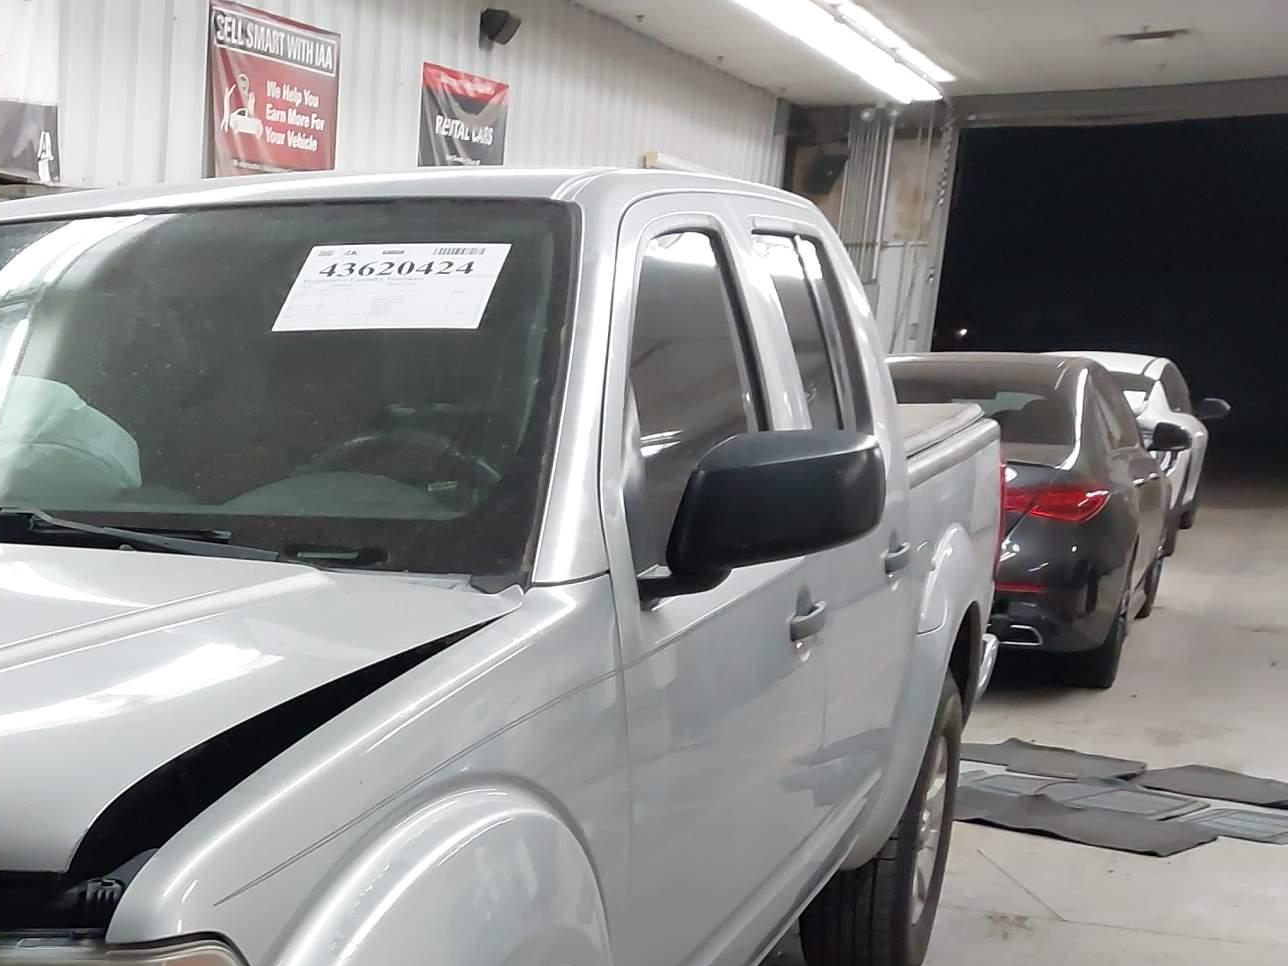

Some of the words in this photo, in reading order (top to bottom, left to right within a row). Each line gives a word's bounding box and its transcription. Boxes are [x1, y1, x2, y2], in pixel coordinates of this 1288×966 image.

[216, 14, 244, 45] SELL
[246, 22, 285, 57] SMART
[287, 34, 314, 65] WITH
[315, 42, 333, 70] IAA
[266, 79, 281, 100] We
[282, 83, 302, 107] Help
[303, 88, 319, 108] You
[265, 102, 286, 123] Earn
[287, 107, 310, 128] More
[310, 112, 325, 131] For
[265, 125, 286, 145] Your
[286, 129, 318, 152] Vehicle
[318, 260, 475, 278] 43620424
